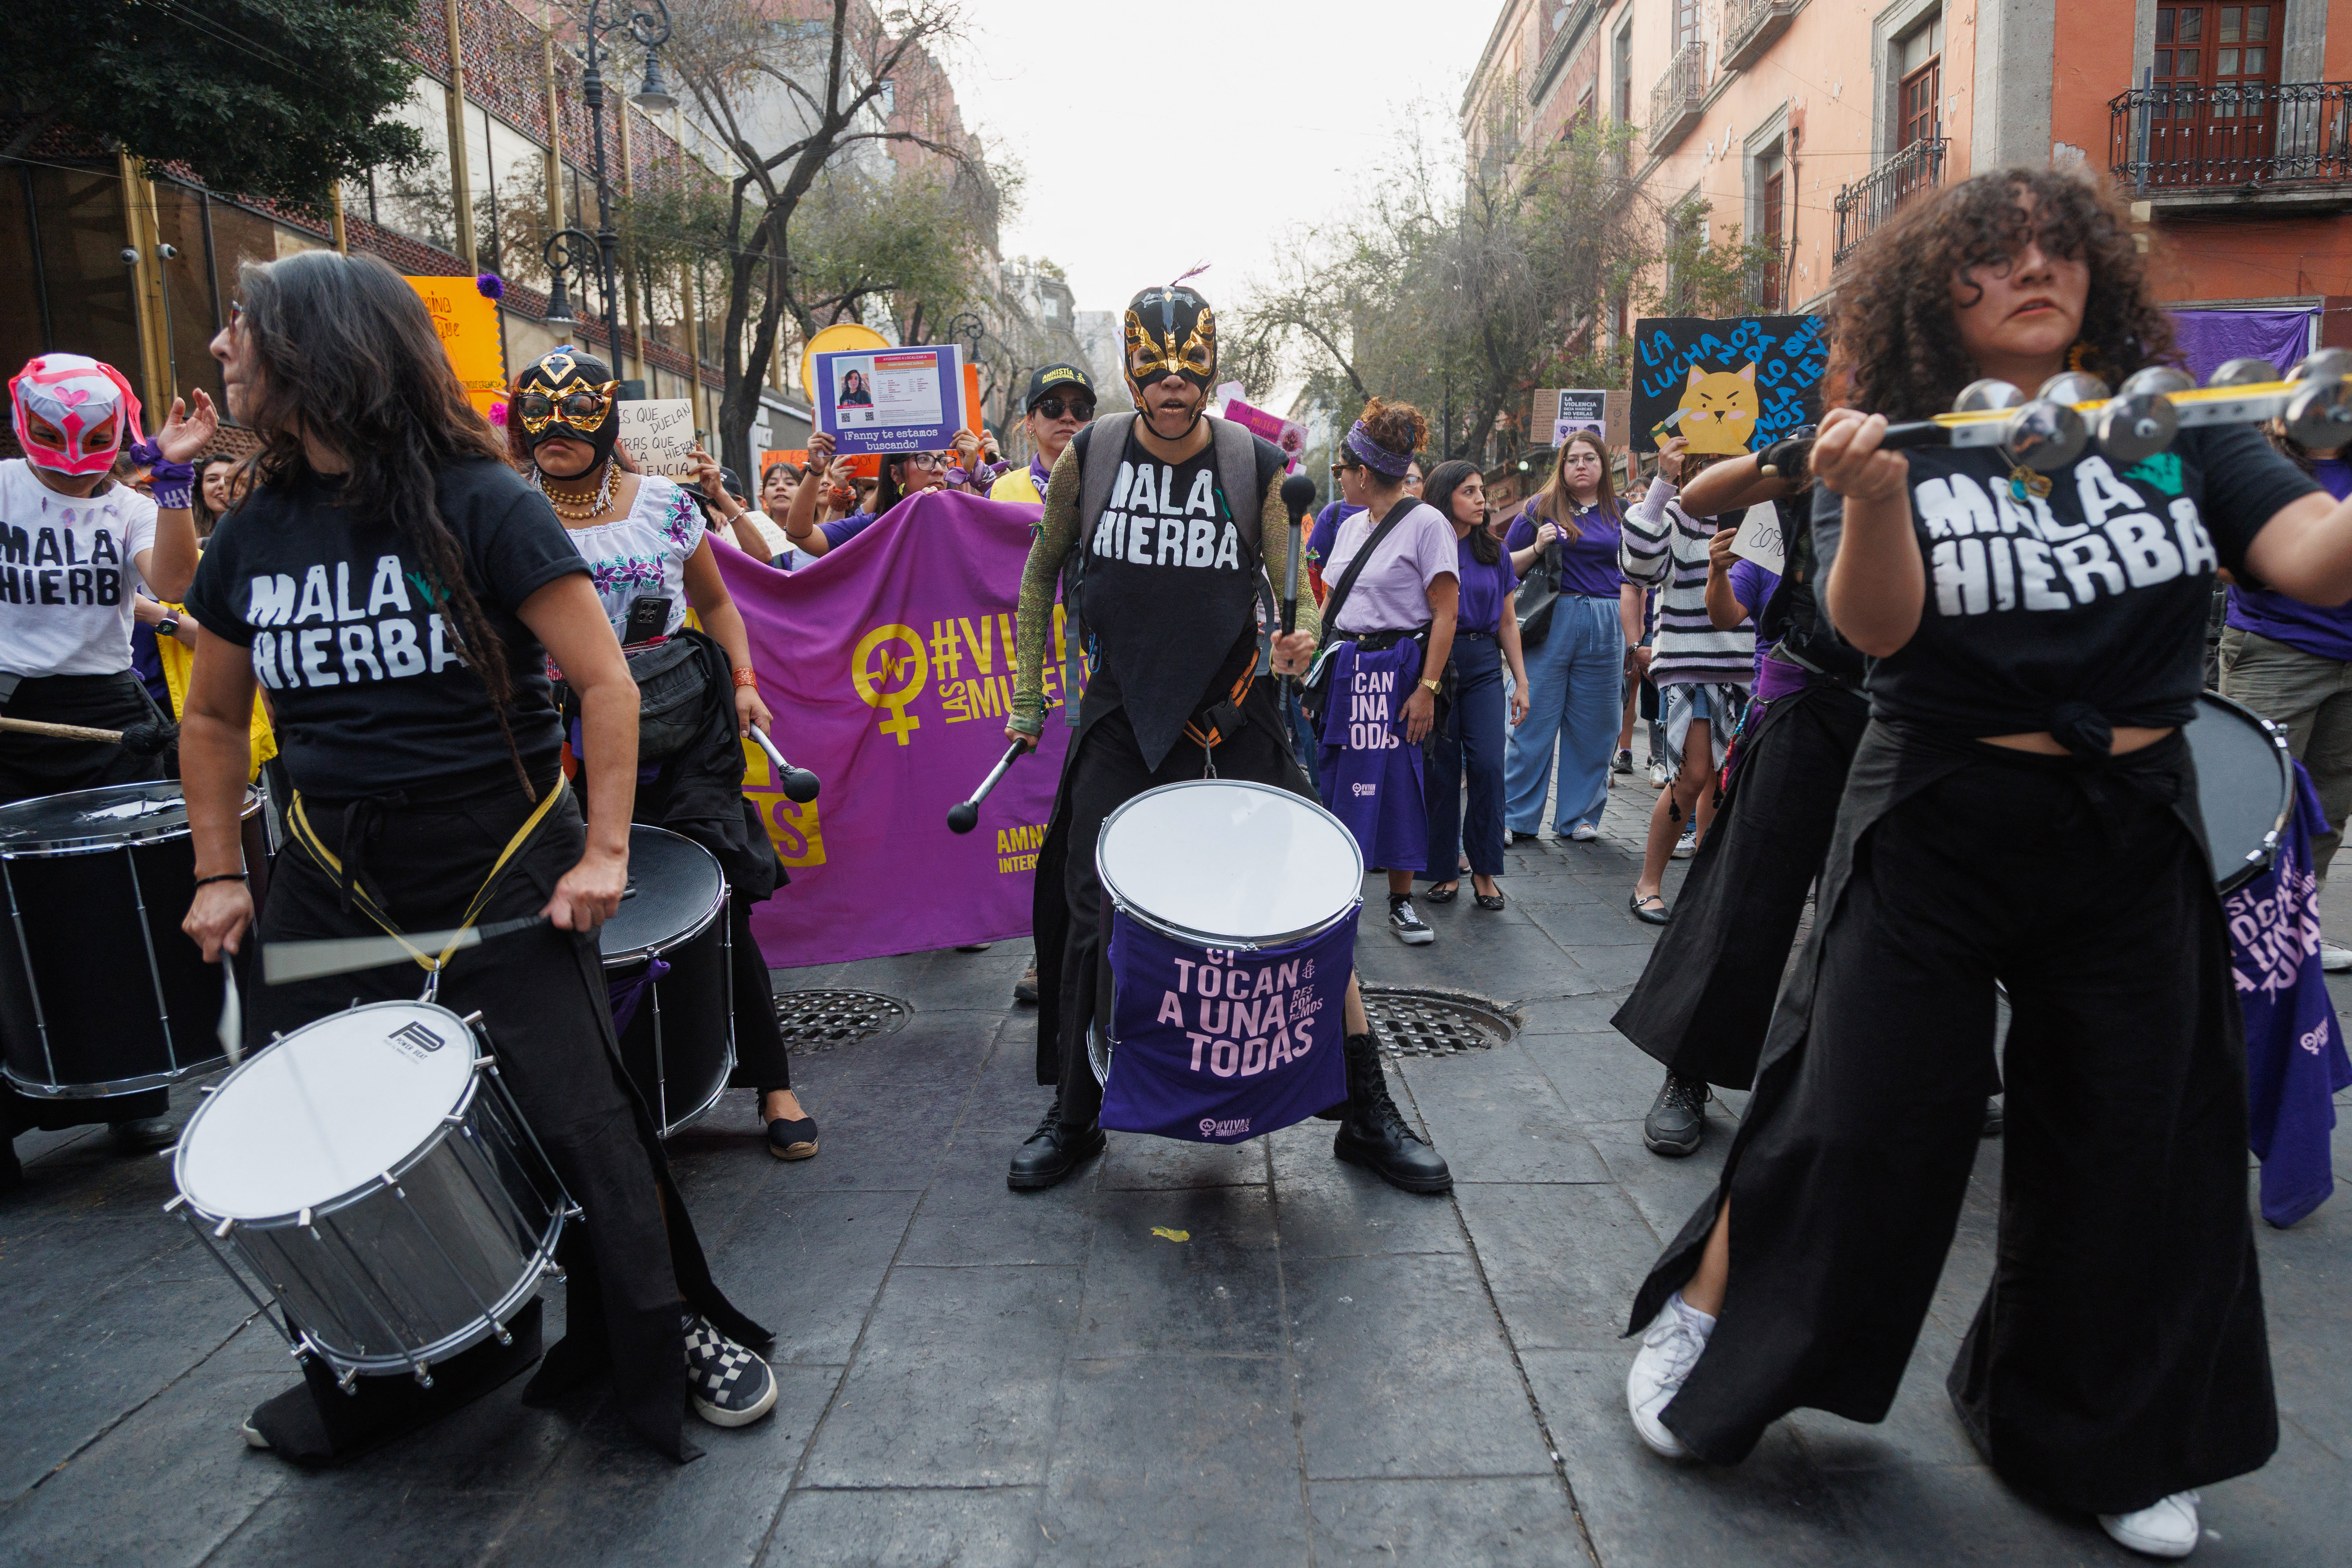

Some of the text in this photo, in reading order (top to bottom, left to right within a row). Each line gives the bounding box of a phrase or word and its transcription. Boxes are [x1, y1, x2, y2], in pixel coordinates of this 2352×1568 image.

[1640, 330, 1675, 366] LA
[1642, 319, 1777, 397] LUCHA NOS DA
[1758, 359, 1788, 387] LO
[1780, 315, 1827, 357] QUE
[1042, 374, 1075, 384] INTERNACIONAL
[1043, 368, 1074, 379] AMNISTÍA
[1763, 387, 1797, 413] LA
[1791, 338, 1829, 388] LEY
[637, 407, 659, 423] QUE
[649, 403, 690, 434] DUELAN
[1755, 401, 1805, 434] NOS
[652, 436, 675, 449] QUE
[844, 428, 938, 441] ¡Fanny te estamos
[865, 439, 918, 450] buscando!
[630, 452, 649, 462] LA
[1110, 461, 1216, 517] MALA
[1914, 455, 2146, 543] MALA
[0, 521, 119, 566] MALA
[1093, 510, 1239, 570] HIERBA
[1931, 497, 2218, 616] HIERBA
[246, 555, 412, 628] MALA
[253, 613, 470, 689] HIERBA
[939, 681, 971, 724] LAS
[1174, 958, 1300, 1000] TOCAN
[1292, 984, 1315, 1001] RES
[1156, 990, 1286, 1039] A UNA
[1287, 997, 1323, 1025] DEMOS
[1290, 993, 1313, 1013] PON
[1186, 1017, 1315, 1078] TODAS
[1216, 1117, 1252, 1130] #VIVAN
[1221, 1124, 1249, 1136] MUJERES
